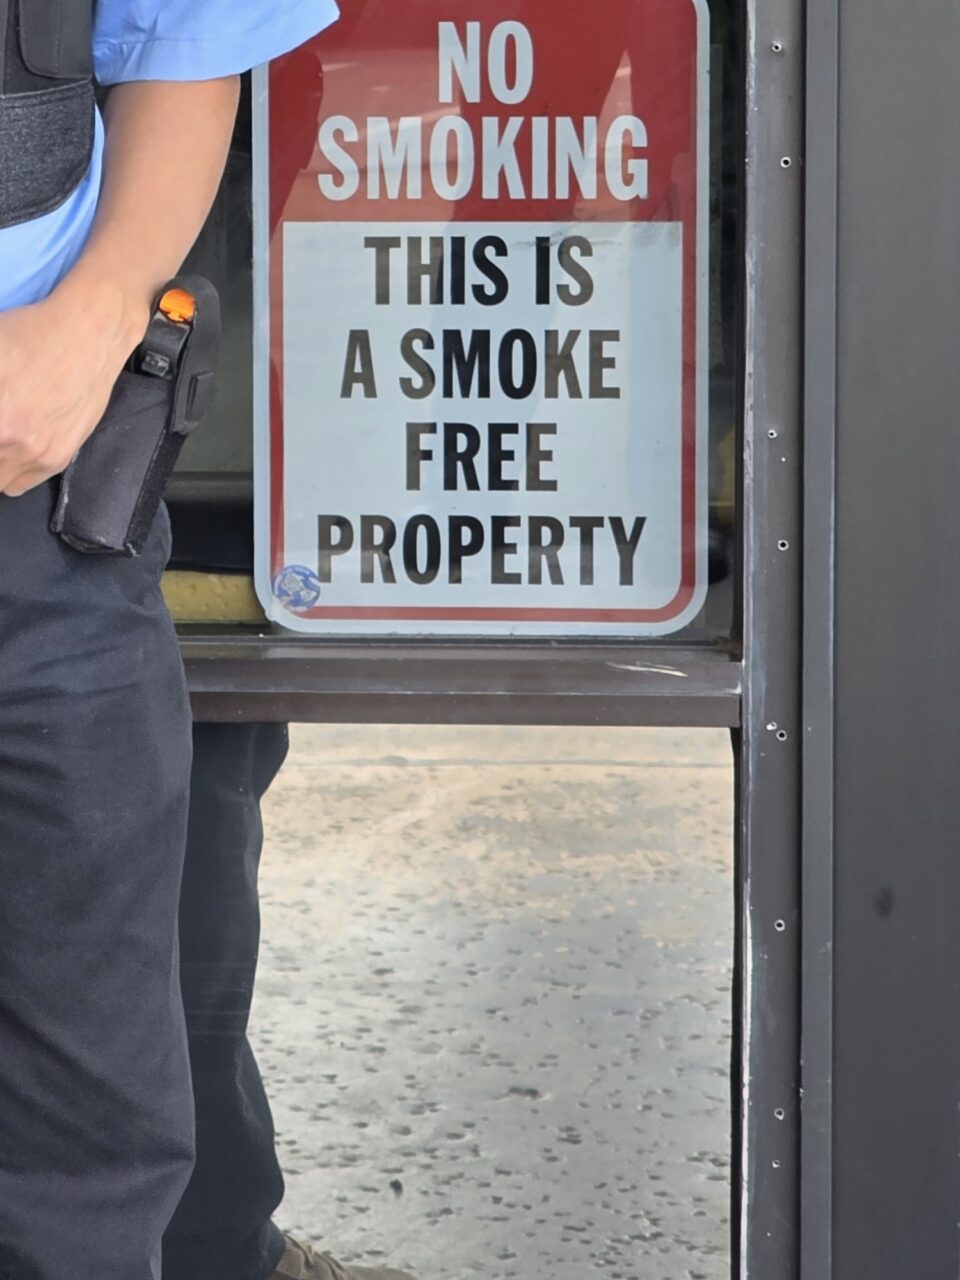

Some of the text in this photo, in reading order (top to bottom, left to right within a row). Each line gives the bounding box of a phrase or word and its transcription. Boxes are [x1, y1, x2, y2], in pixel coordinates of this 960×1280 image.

[438, 20, 534, 104] NO
[317, 115, 649, 201] SMOKING
[363, 234, 595, 306] THIS IS
[340, 328, 621, 400] A SMOKE
[405, 421, 558, 492] FREE
[317, 514, 648, 586] PROPERTY
